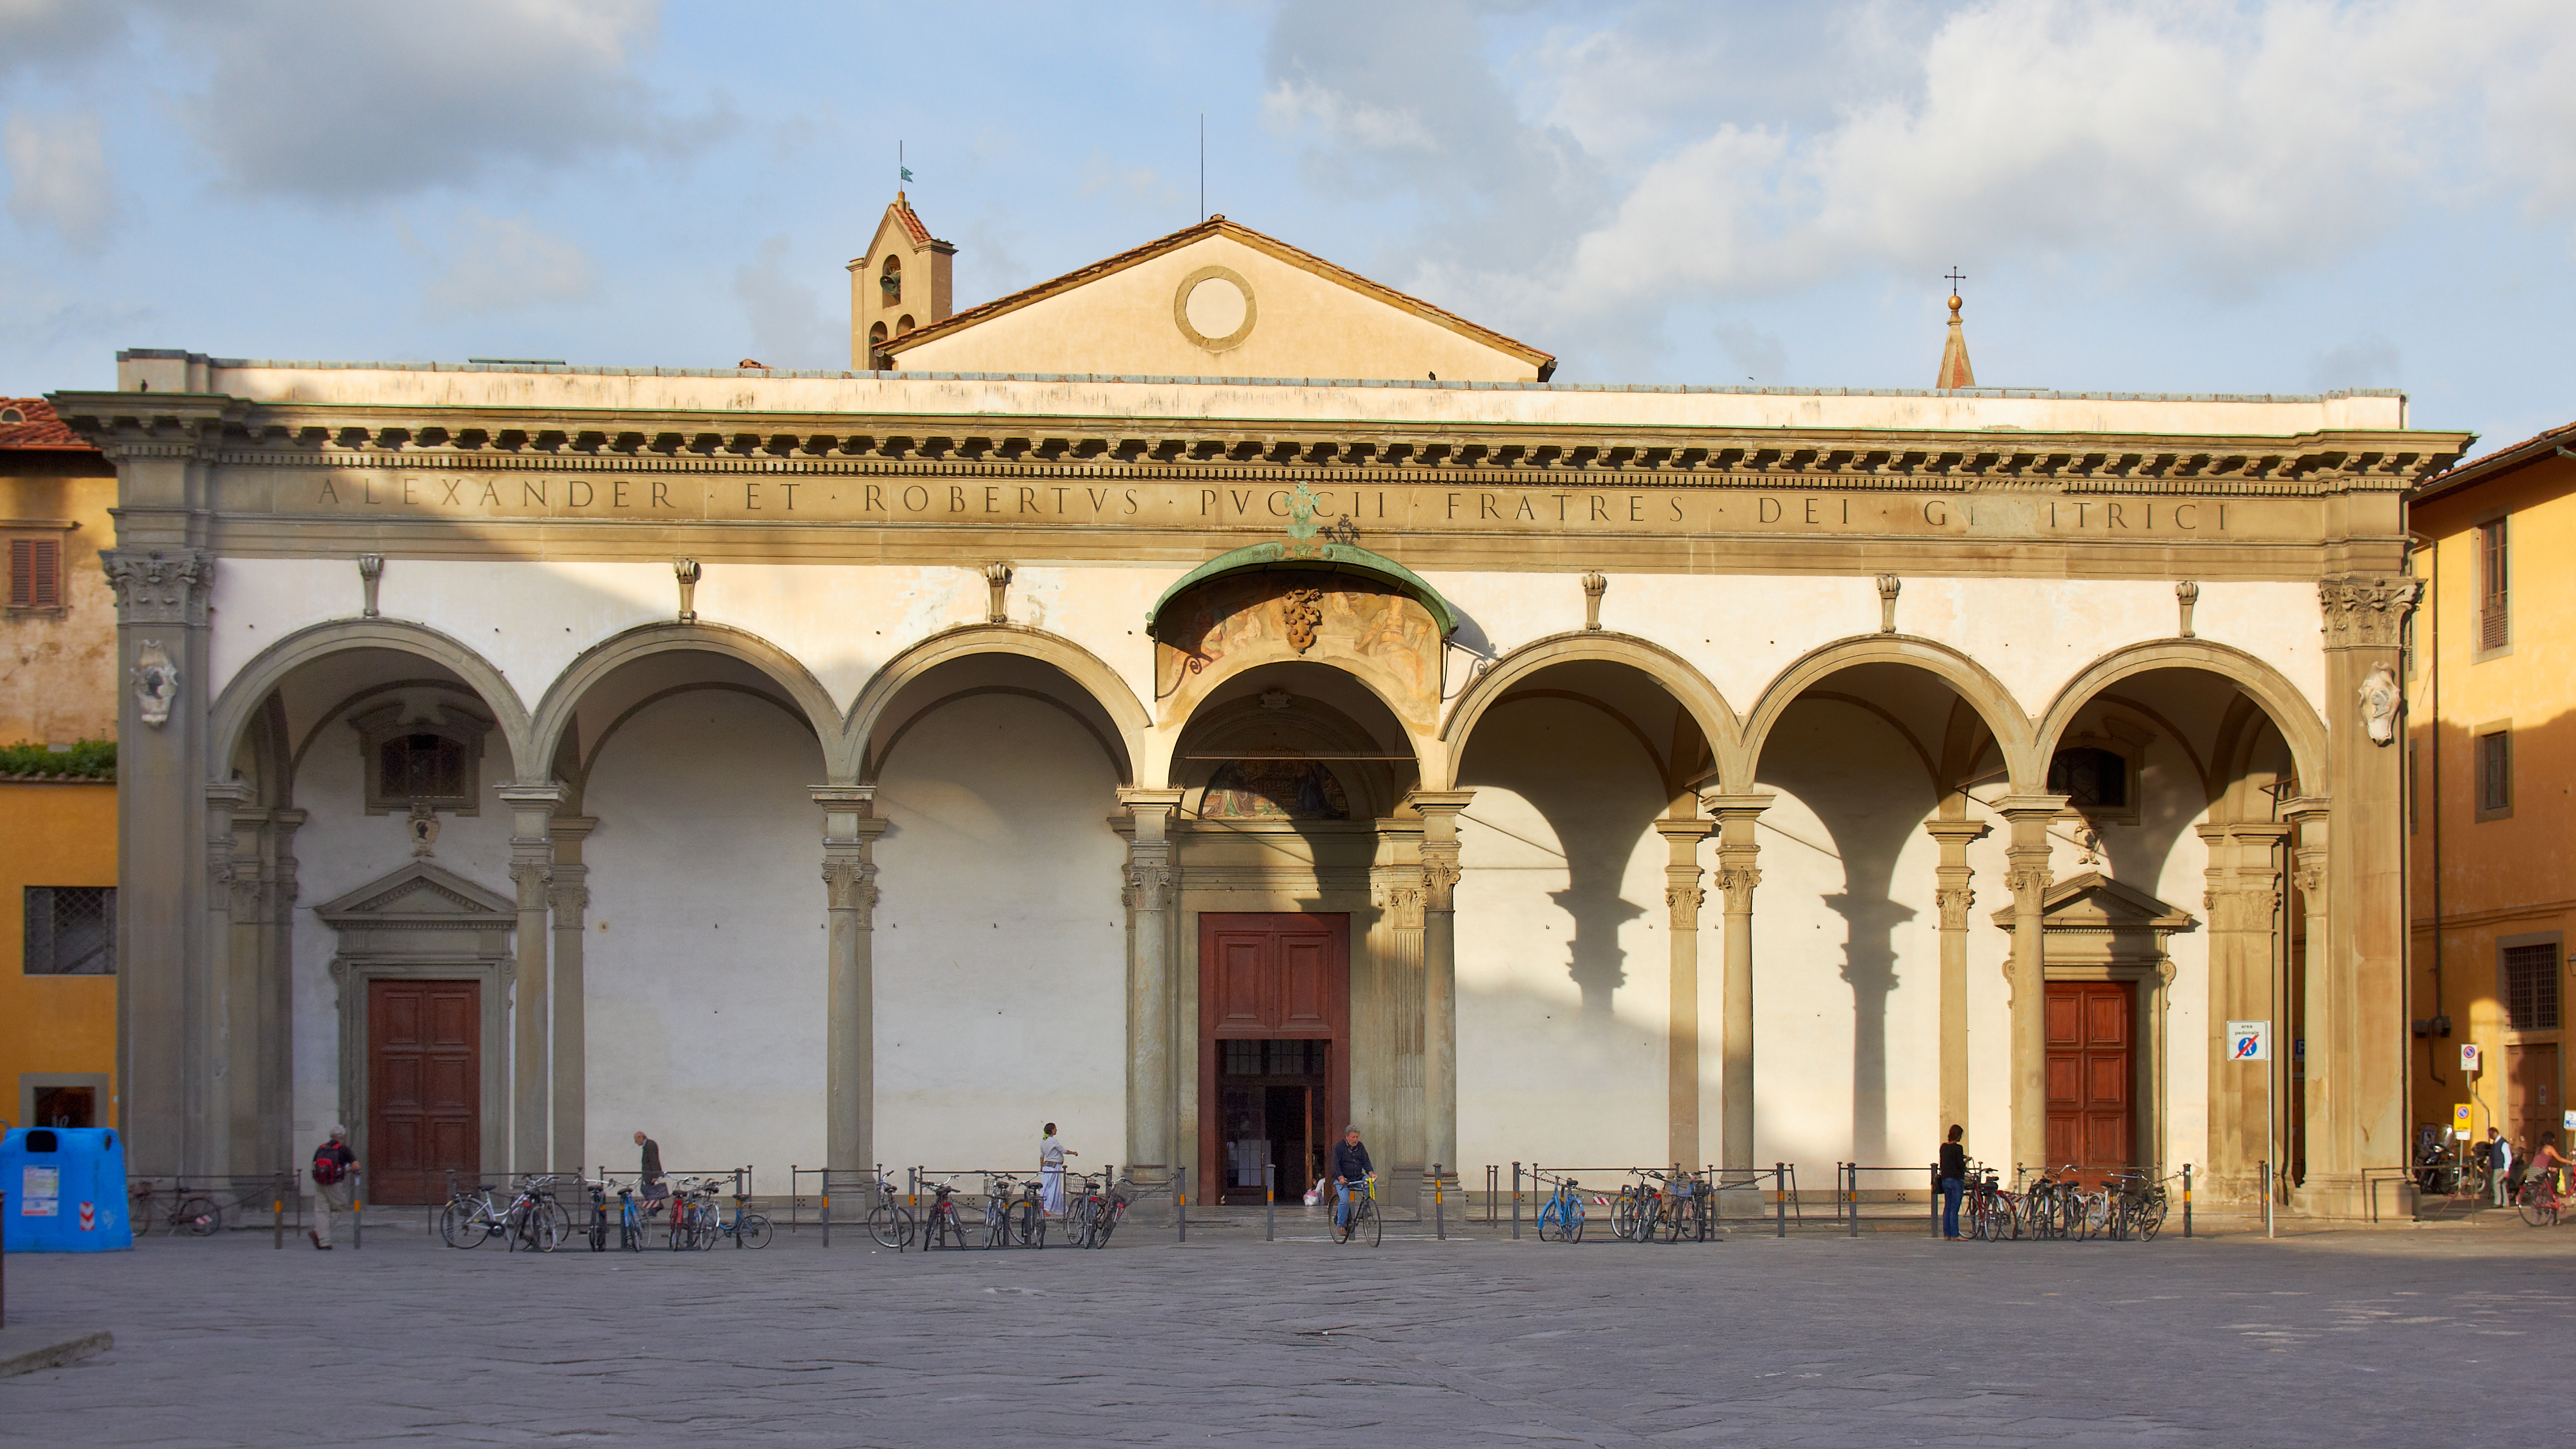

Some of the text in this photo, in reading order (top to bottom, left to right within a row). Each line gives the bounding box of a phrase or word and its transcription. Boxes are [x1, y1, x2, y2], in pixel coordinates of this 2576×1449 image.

[318, 478, 2225, 530] ALEXANDER ET ROBERTVS PVCCII FRATRES DEI GITRICI
